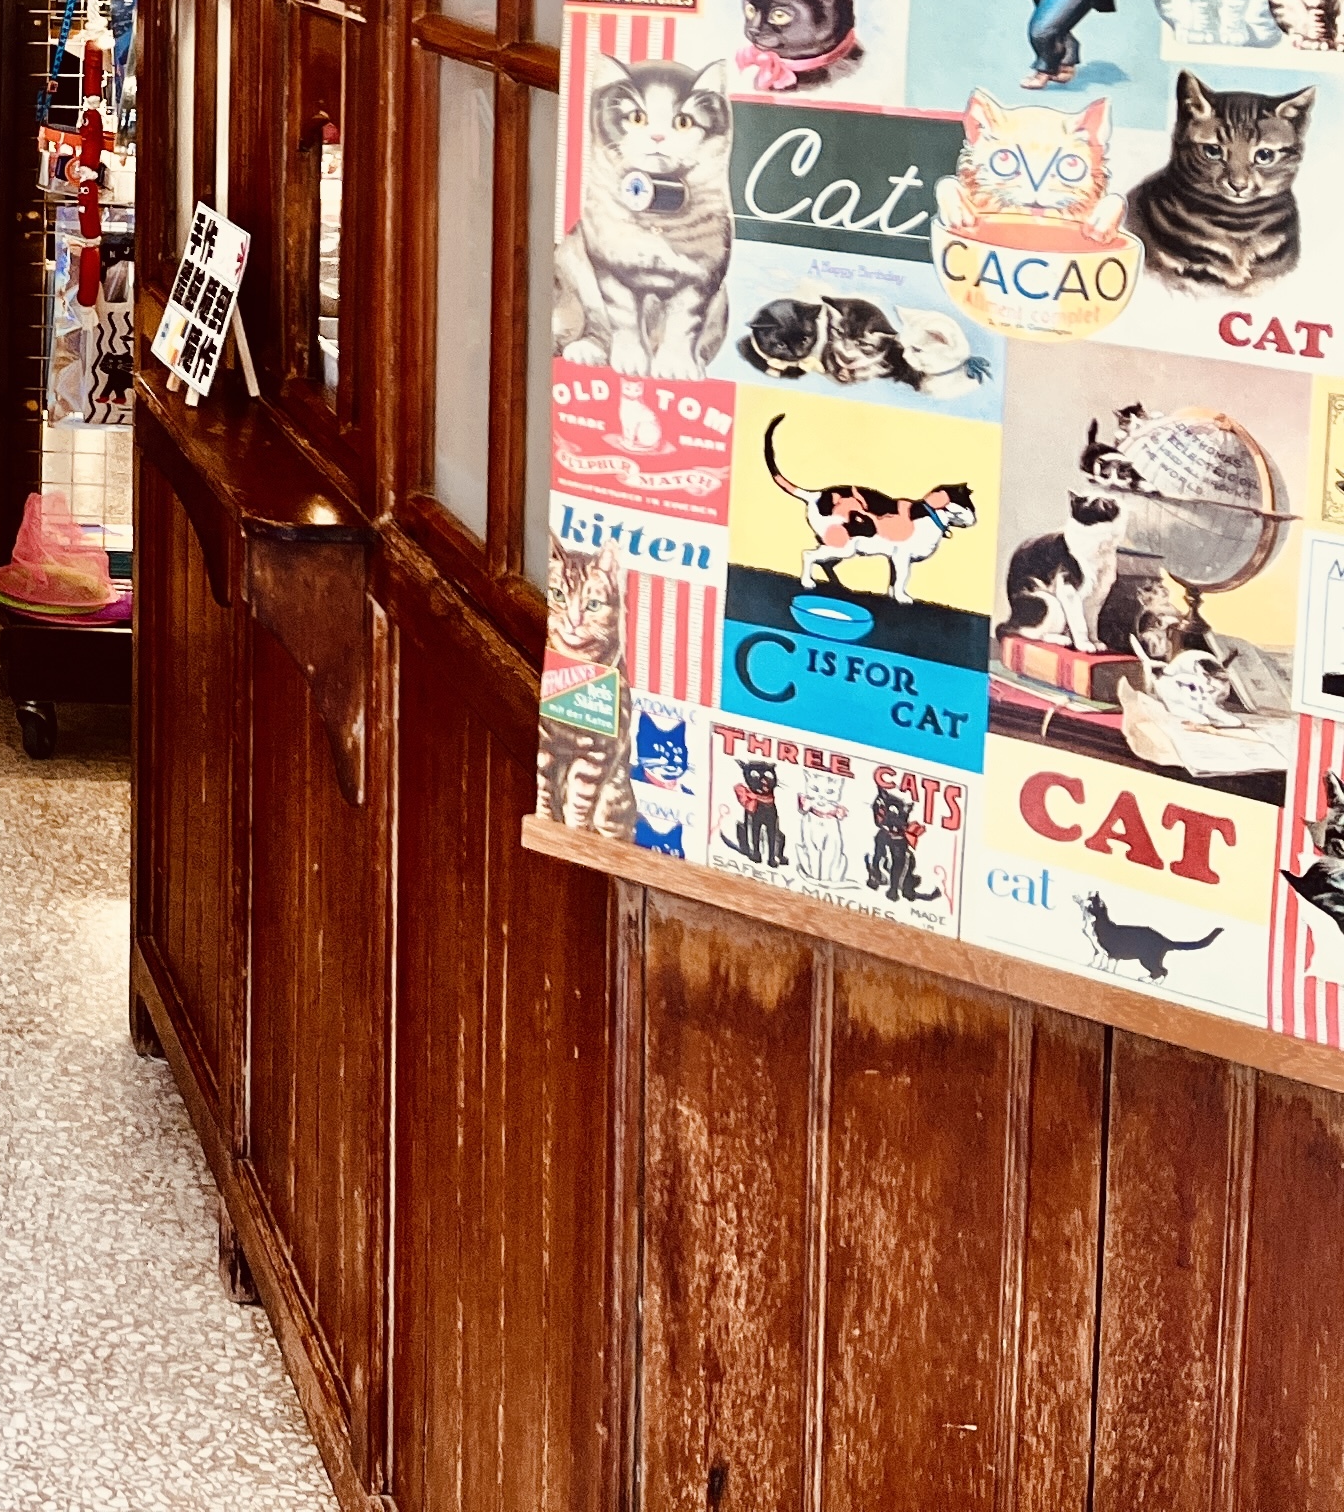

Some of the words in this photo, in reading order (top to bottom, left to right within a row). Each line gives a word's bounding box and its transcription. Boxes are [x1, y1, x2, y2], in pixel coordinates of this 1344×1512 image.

[746, 127, 930, 234] Cat
[941, 240, 1128, 303] CACAO
[1219, 311, 1332, 359] CAT
[552, 380, 610, 405] OLD
[656, 388, 733, 436] TOM
[639, 473, 714, 488] MATCH
[560, 504, 711, 570] kitten
[736, 631, 796, 703] C
[807, 648, 838, 676] IS
[845, 656, 919, 697] FOR
[891, 700, 970, 740] CAT
[713, 727, 855, 780] THREE
[874, 766, 962, 831] CATS
[1020, 771, 1236, 885] CAT
[713, 855, 795, 888] SAFETY
[987, 868, 1056, 911] cat
[911, 907, 947, 927] MADE
